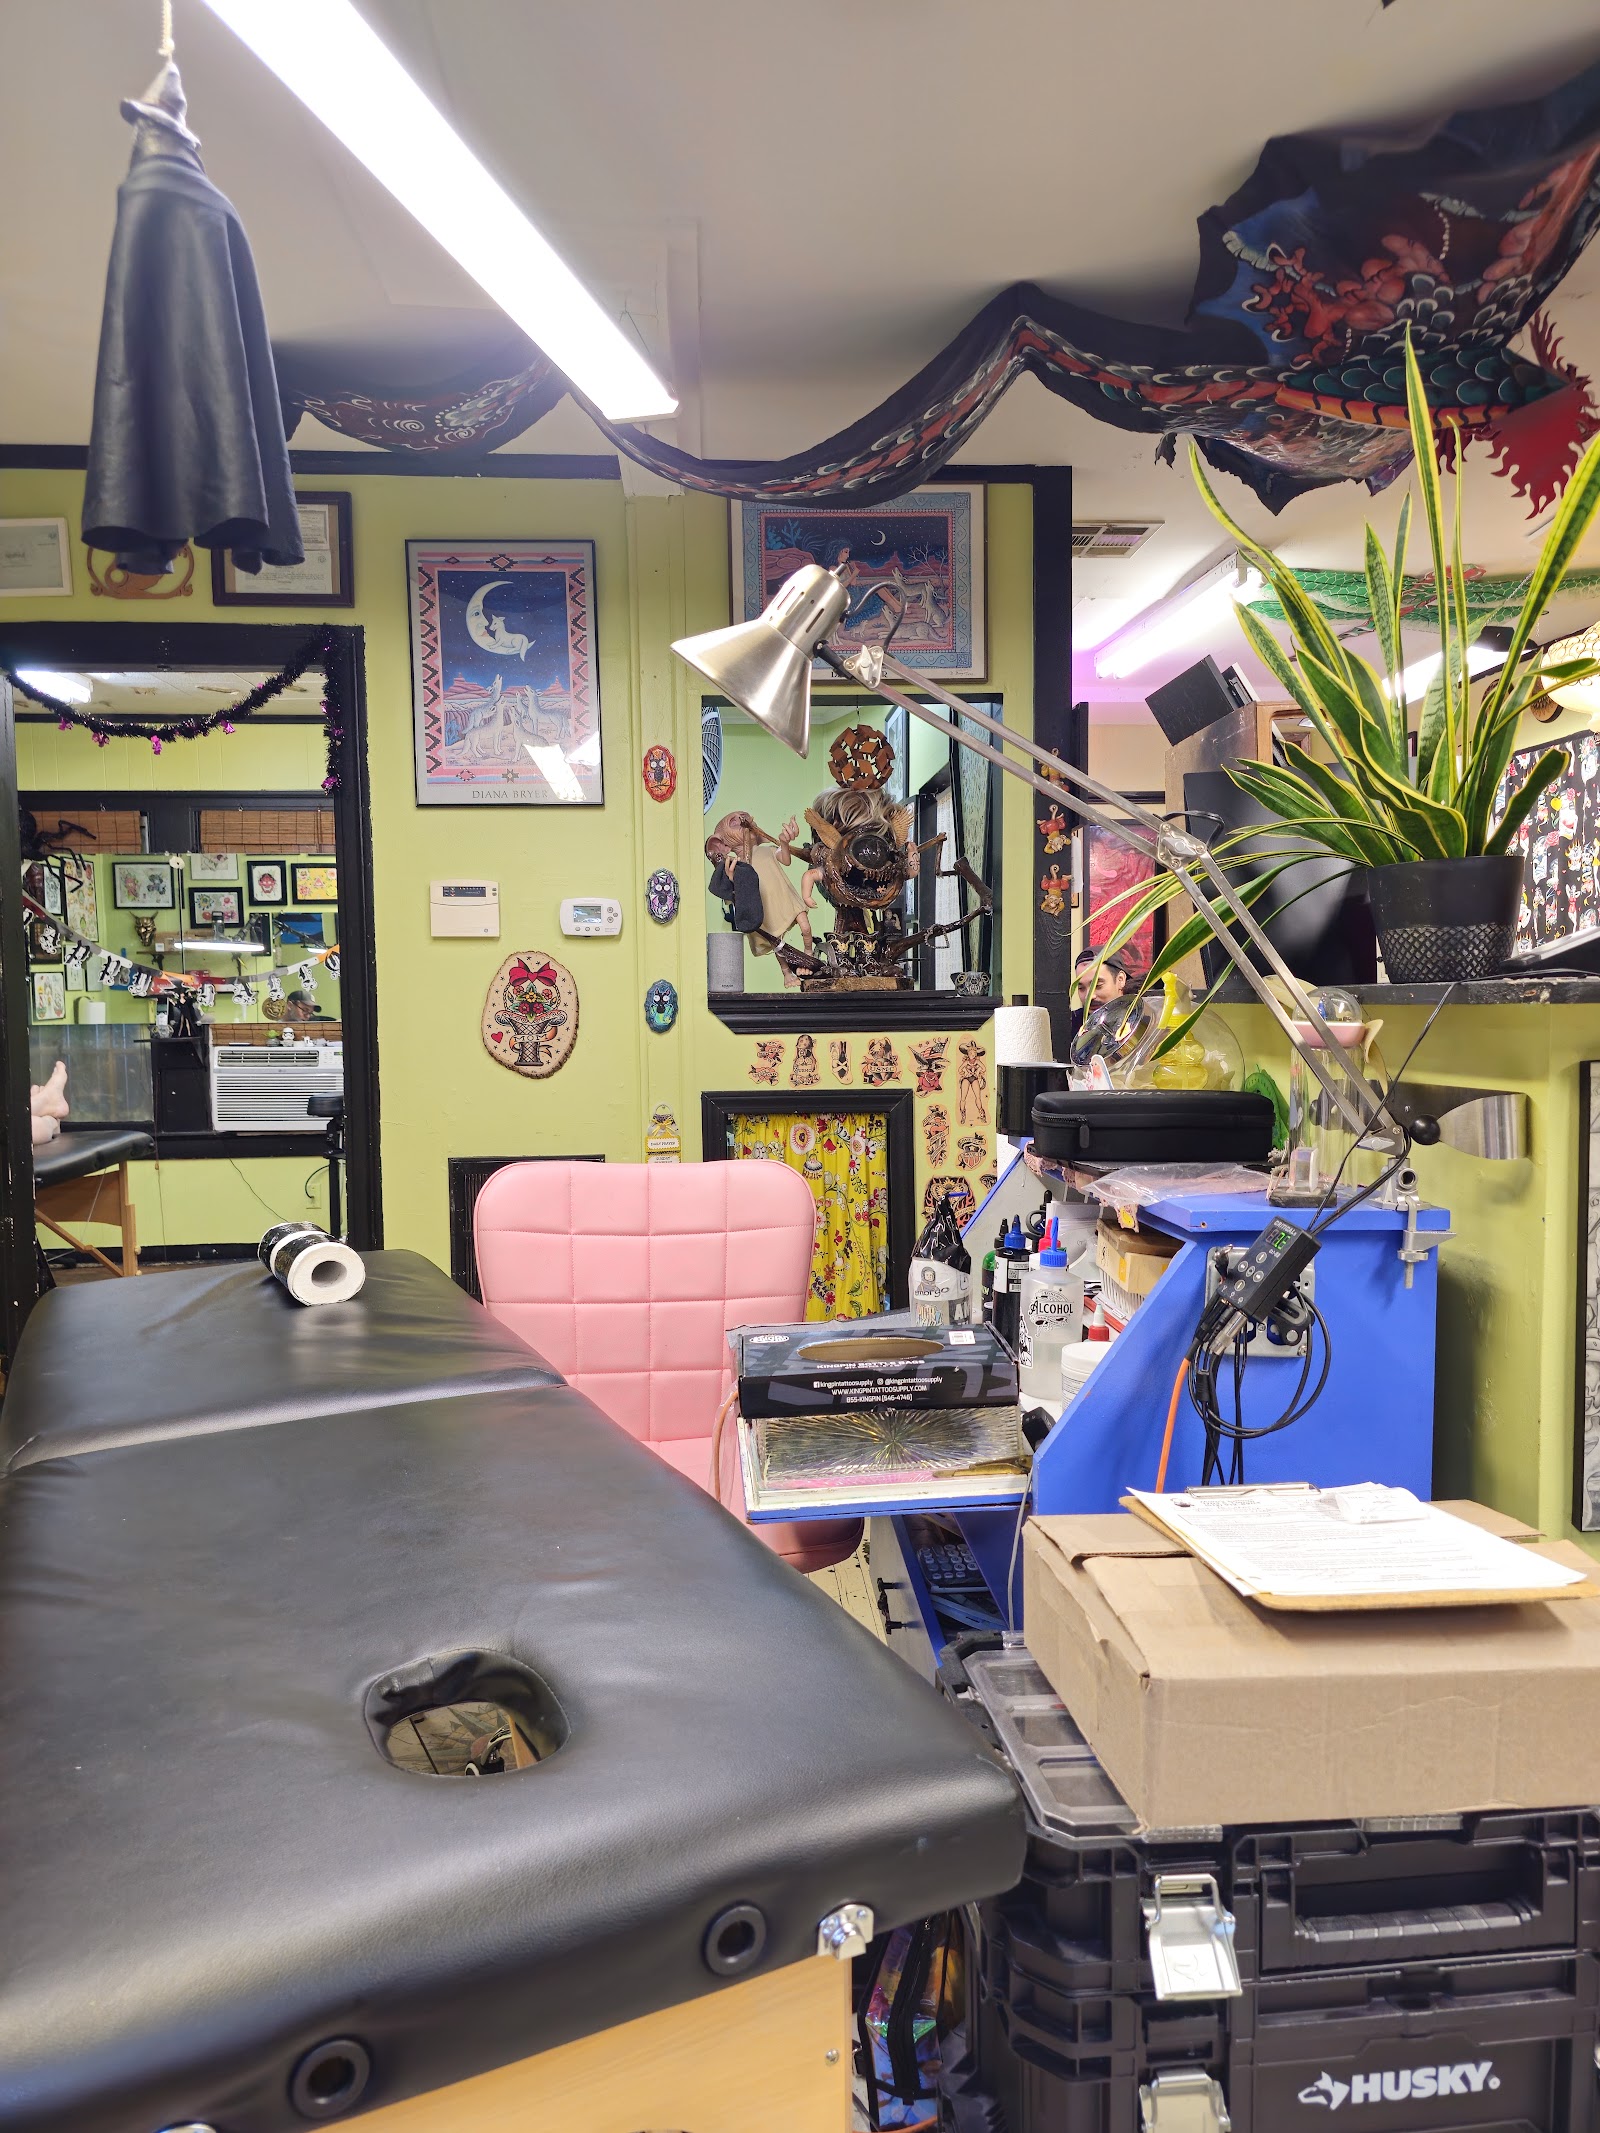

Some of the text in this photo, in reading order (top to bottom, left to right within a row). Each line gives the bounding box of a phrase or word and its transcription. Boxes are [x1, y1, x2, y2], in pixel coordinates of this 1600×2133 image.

[472, 789, 548, 799] DIANA BRYER
[1029, 1300, 1073, 1315] ALCOHOL
[820, 1375, 943, 1389] kingpintattoosupply @kingpintattoosupply
[831, 1384, 928, 1396] WWW.KINGPINTATTOOSUPPLY.COM
[846, 1395, 881, 1404] 855-KINGPIN
[1351, 2061, 1493, 2104] HUSKY
